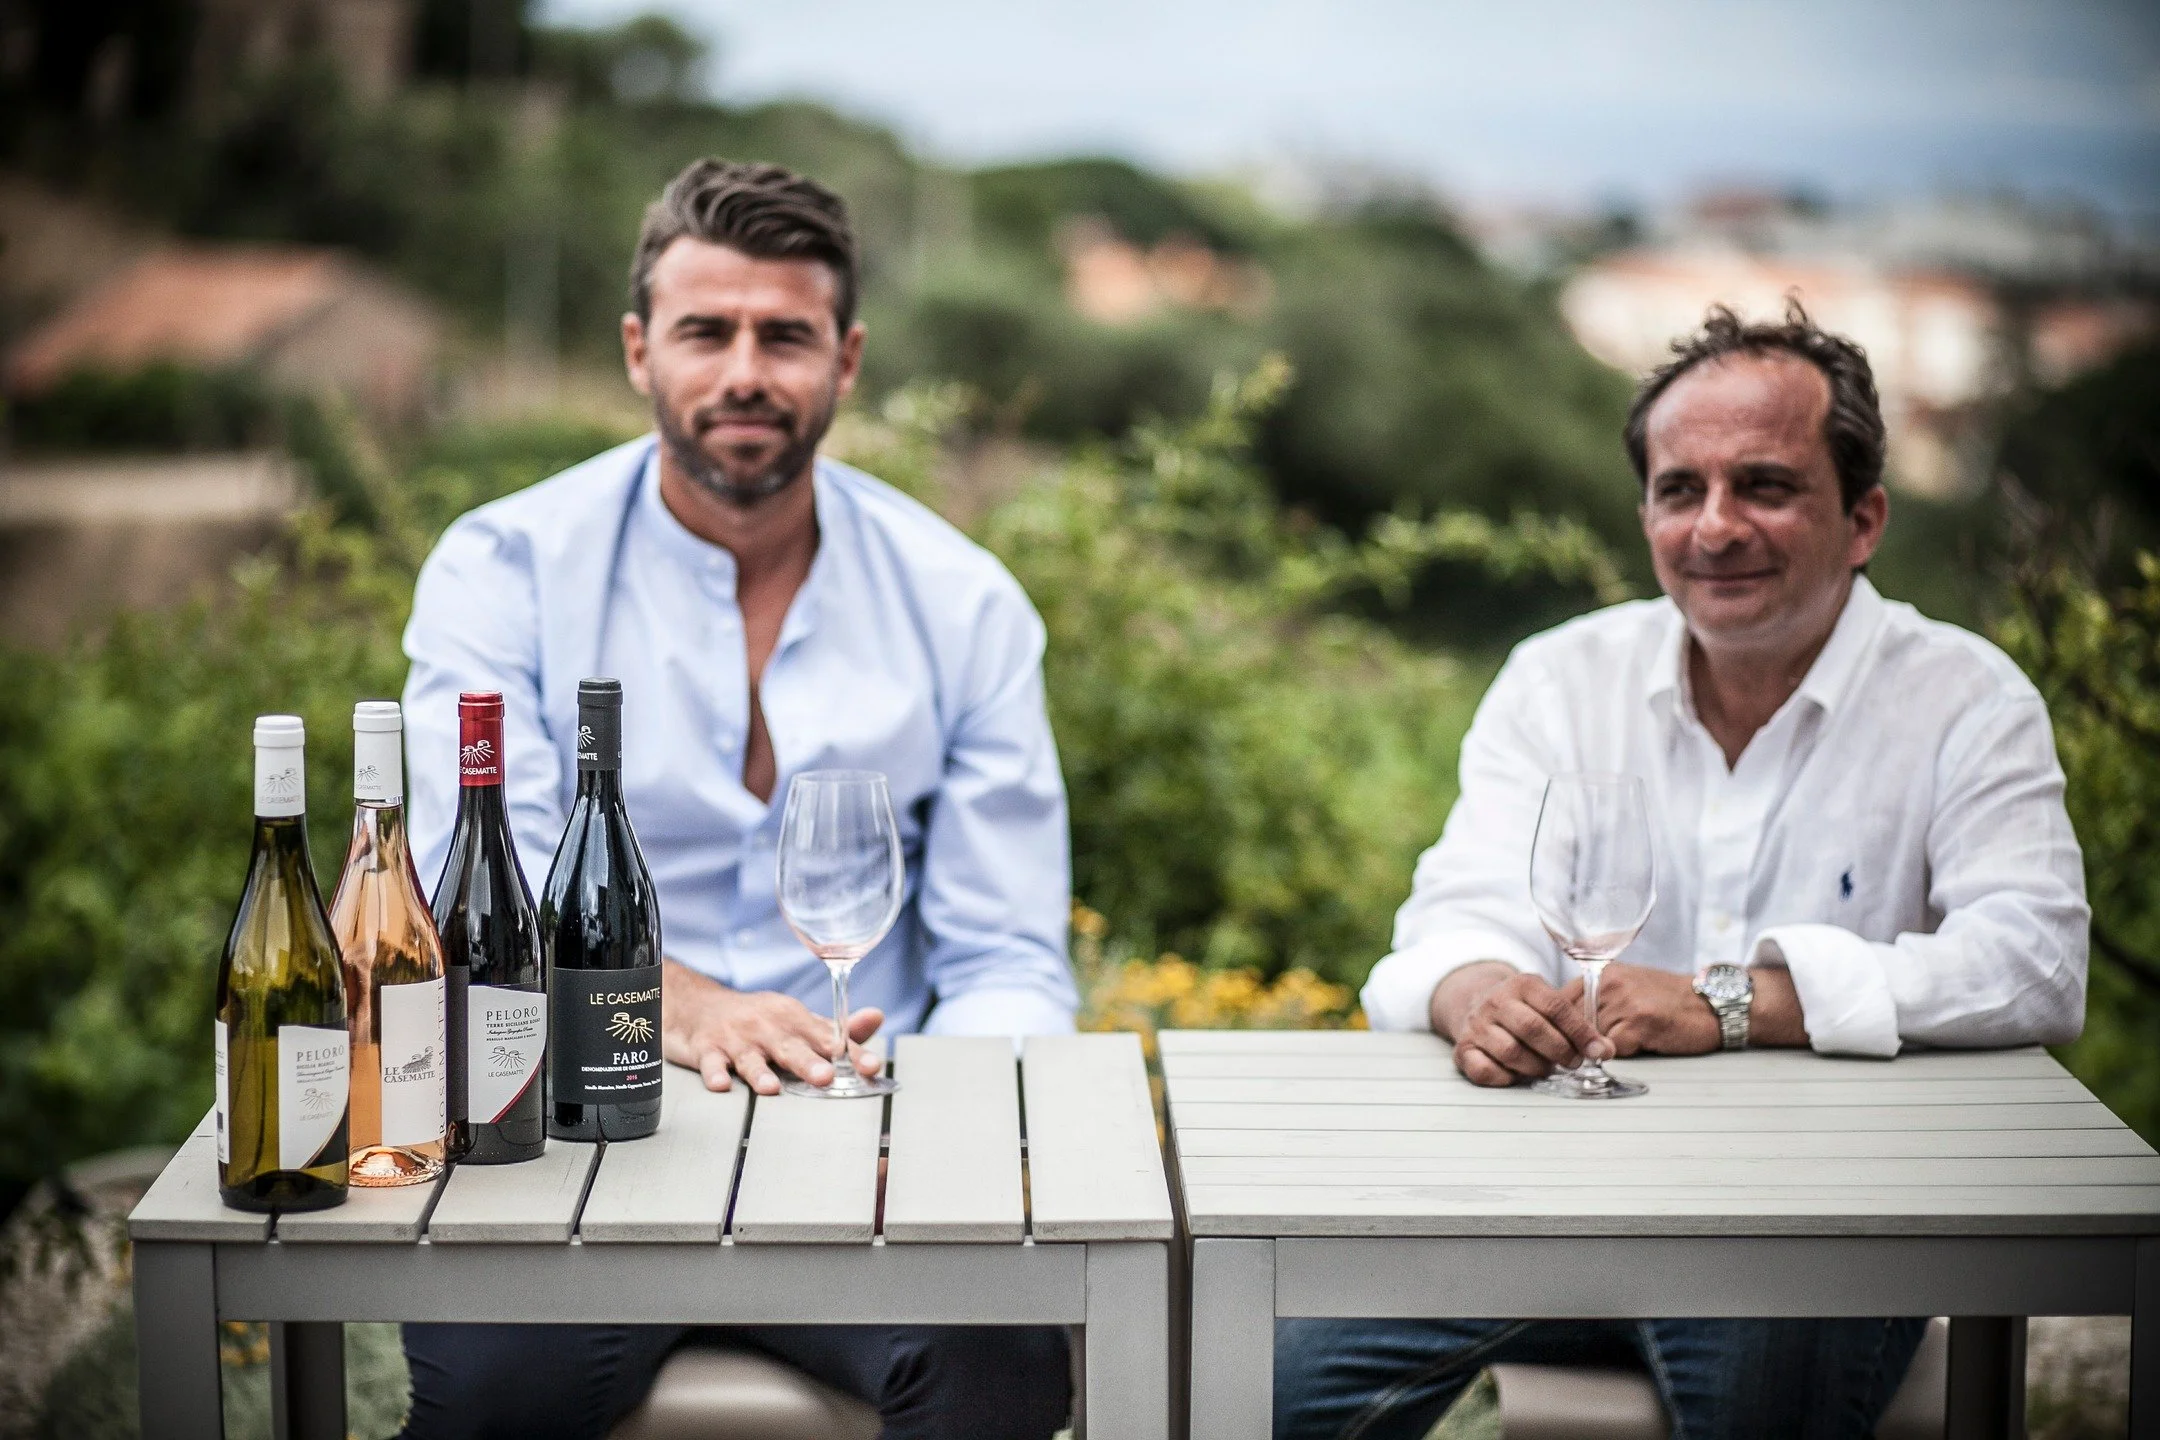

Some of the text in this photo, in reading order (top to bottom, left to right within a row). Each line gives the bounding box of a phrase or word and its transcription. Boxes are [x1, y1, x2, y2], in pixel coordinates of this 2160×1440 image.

[462, 766, 497, 775] CASEMATTE
[590, 987, 661, 1005] LE CASEMATTE
[486, 1005, 538, 1021] PELORO
[296, 1044, 345, 1063] PELORO
[613, 1050, 649, 1065] FARO
[384, 1066, 435, 1083] LE CASEMATTE
[495, 1069, 524, 1077] CASEMATTE
